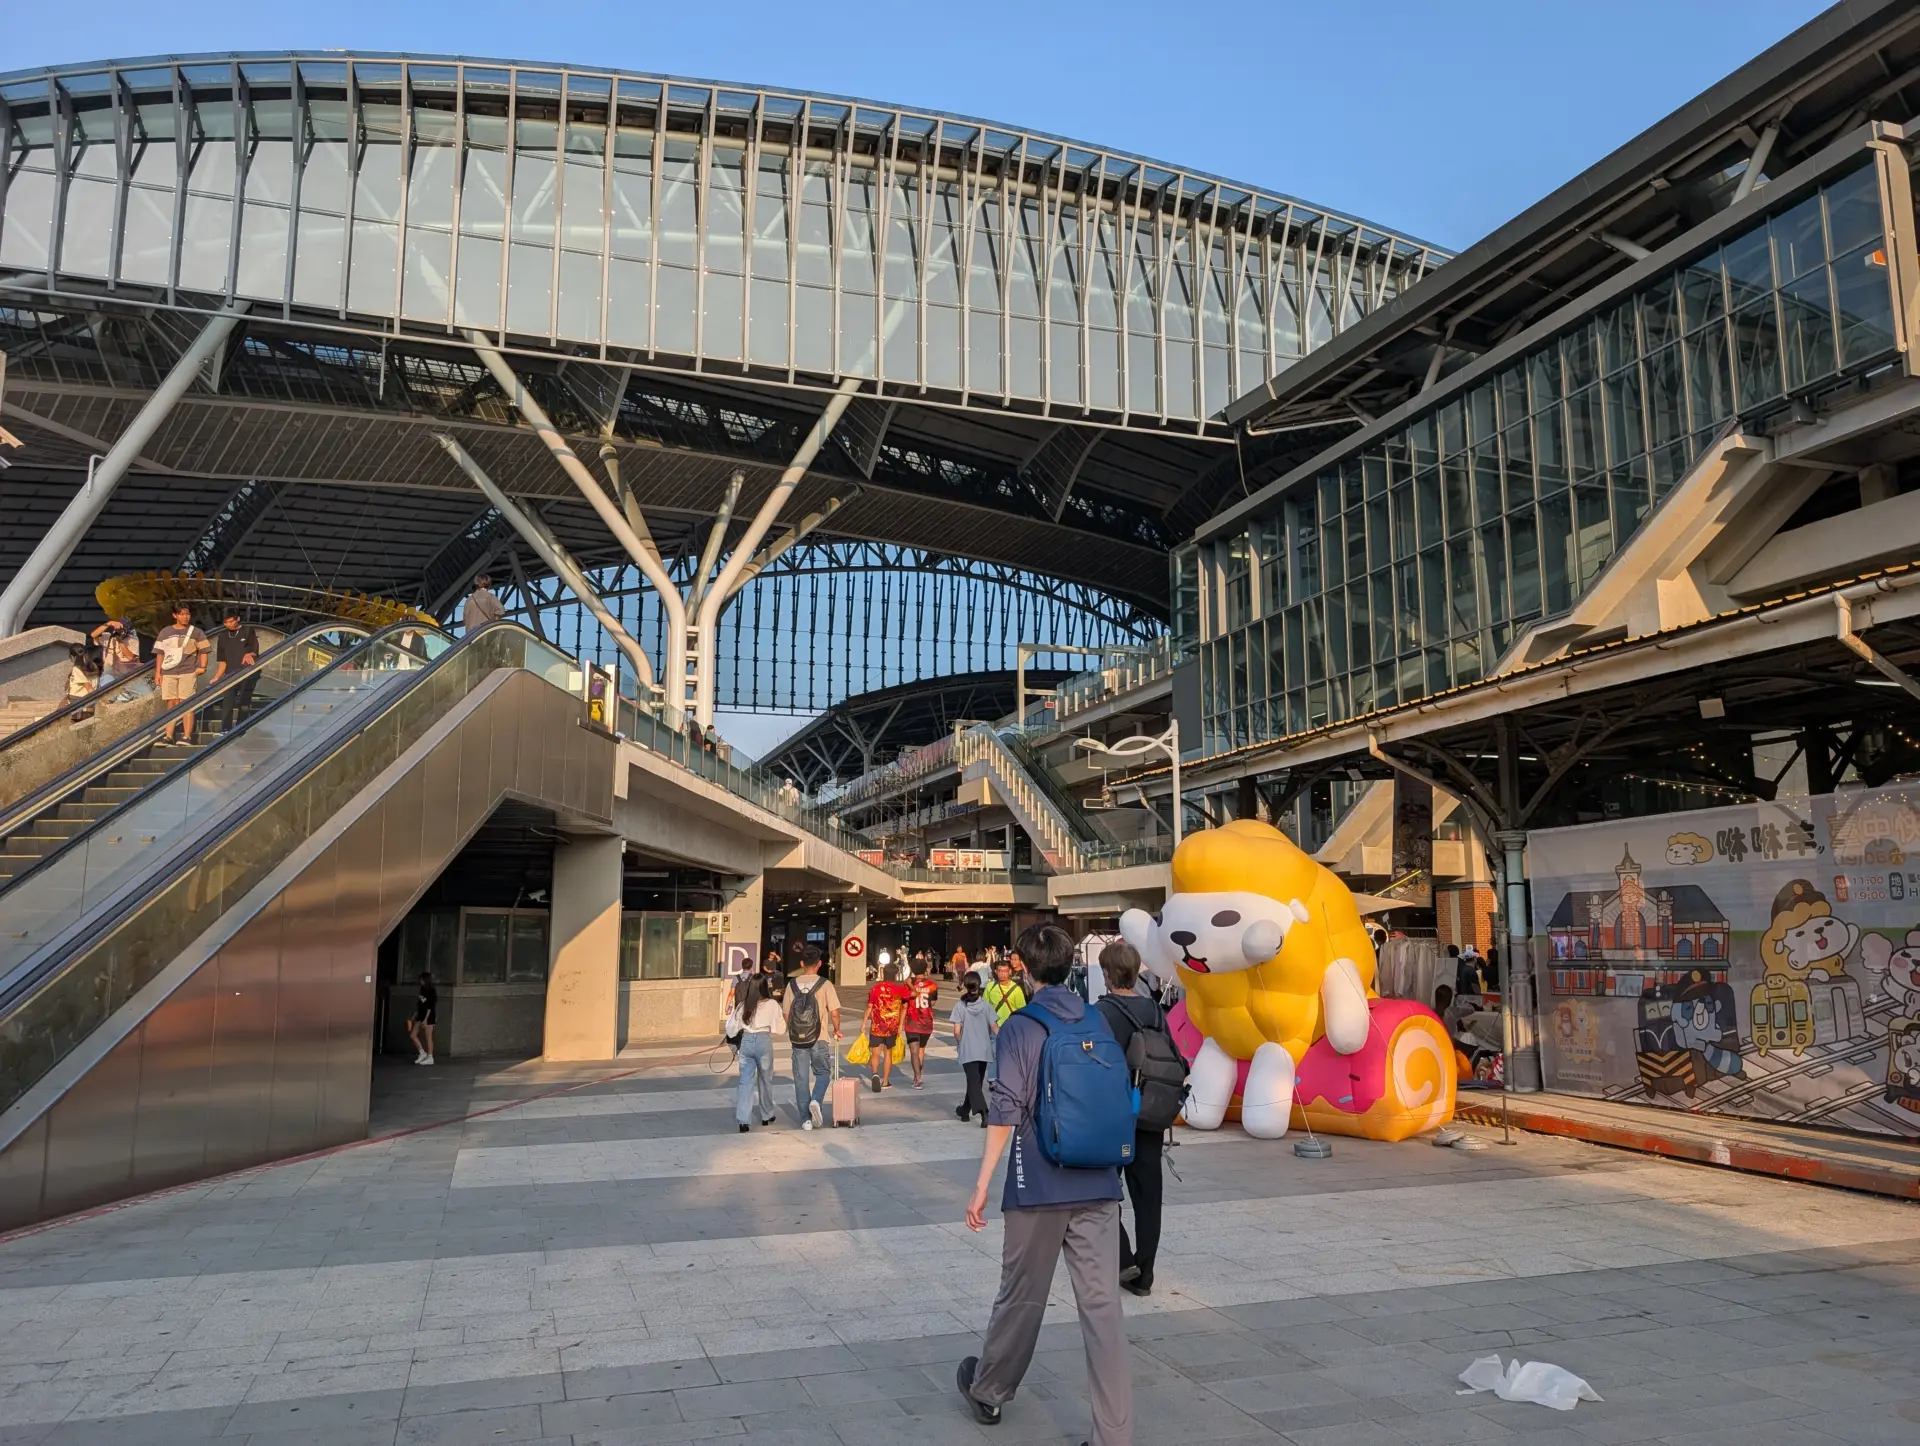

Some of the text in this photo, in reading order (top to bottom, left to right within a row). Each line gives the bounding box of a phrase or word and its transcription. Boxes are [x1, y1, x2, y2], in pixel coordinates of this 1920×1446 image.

[1852, 876, 1884, 885] 11:00
[1852, 891, 1886, 900] 19:00
[711, 916, 718, 926] P
[723, 916, 729, 926] P
[727, 946, 750, 976] D
[915, 993, 929, 1009] 16
